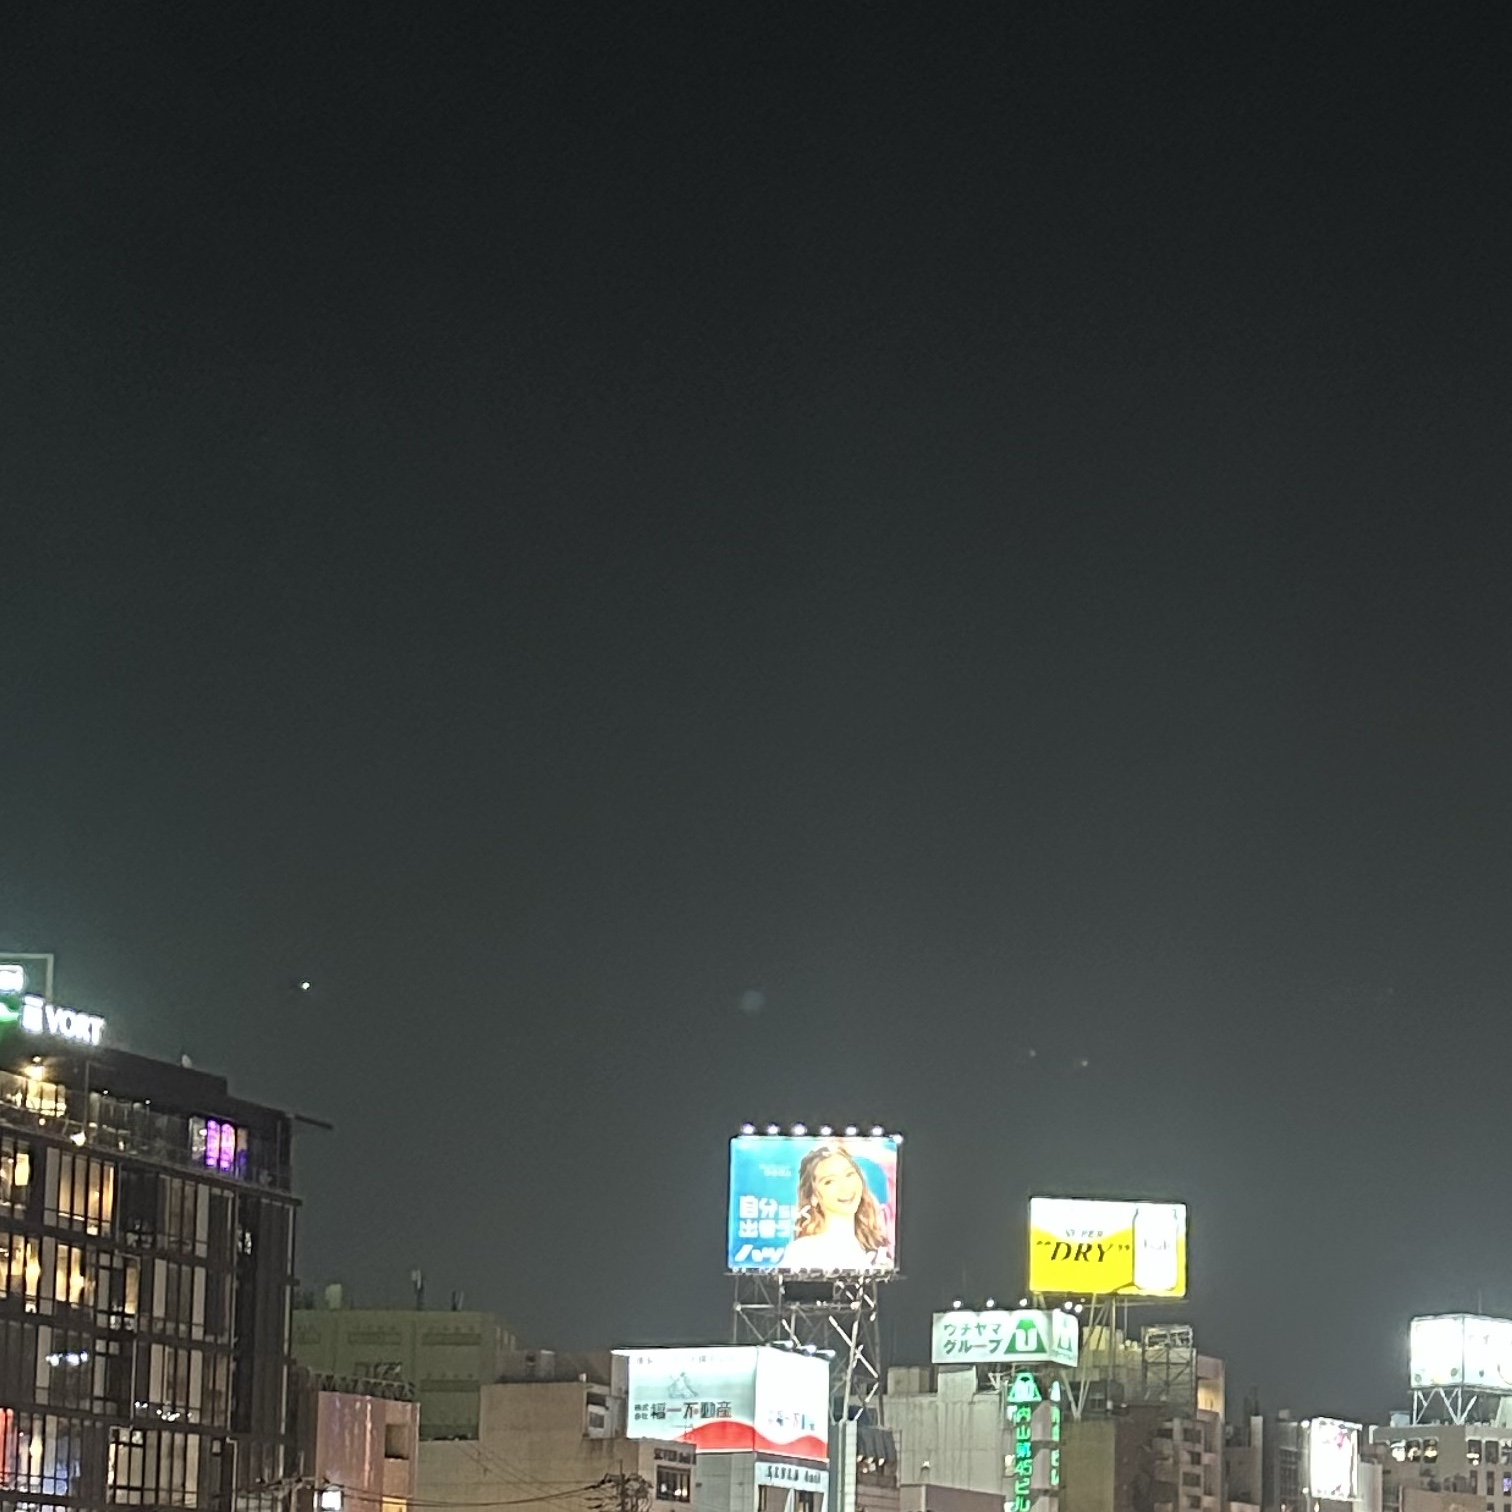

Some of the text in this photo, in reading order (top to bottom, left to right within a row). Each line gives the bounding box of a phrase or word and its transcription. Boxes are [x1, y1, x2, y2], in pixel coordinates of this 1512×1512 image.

[45, 1004, 105, 1046] VORT
[943, 1322, 1002, 1337] ウチヤマ
[943, 1338, 1004, 1355] グループ
